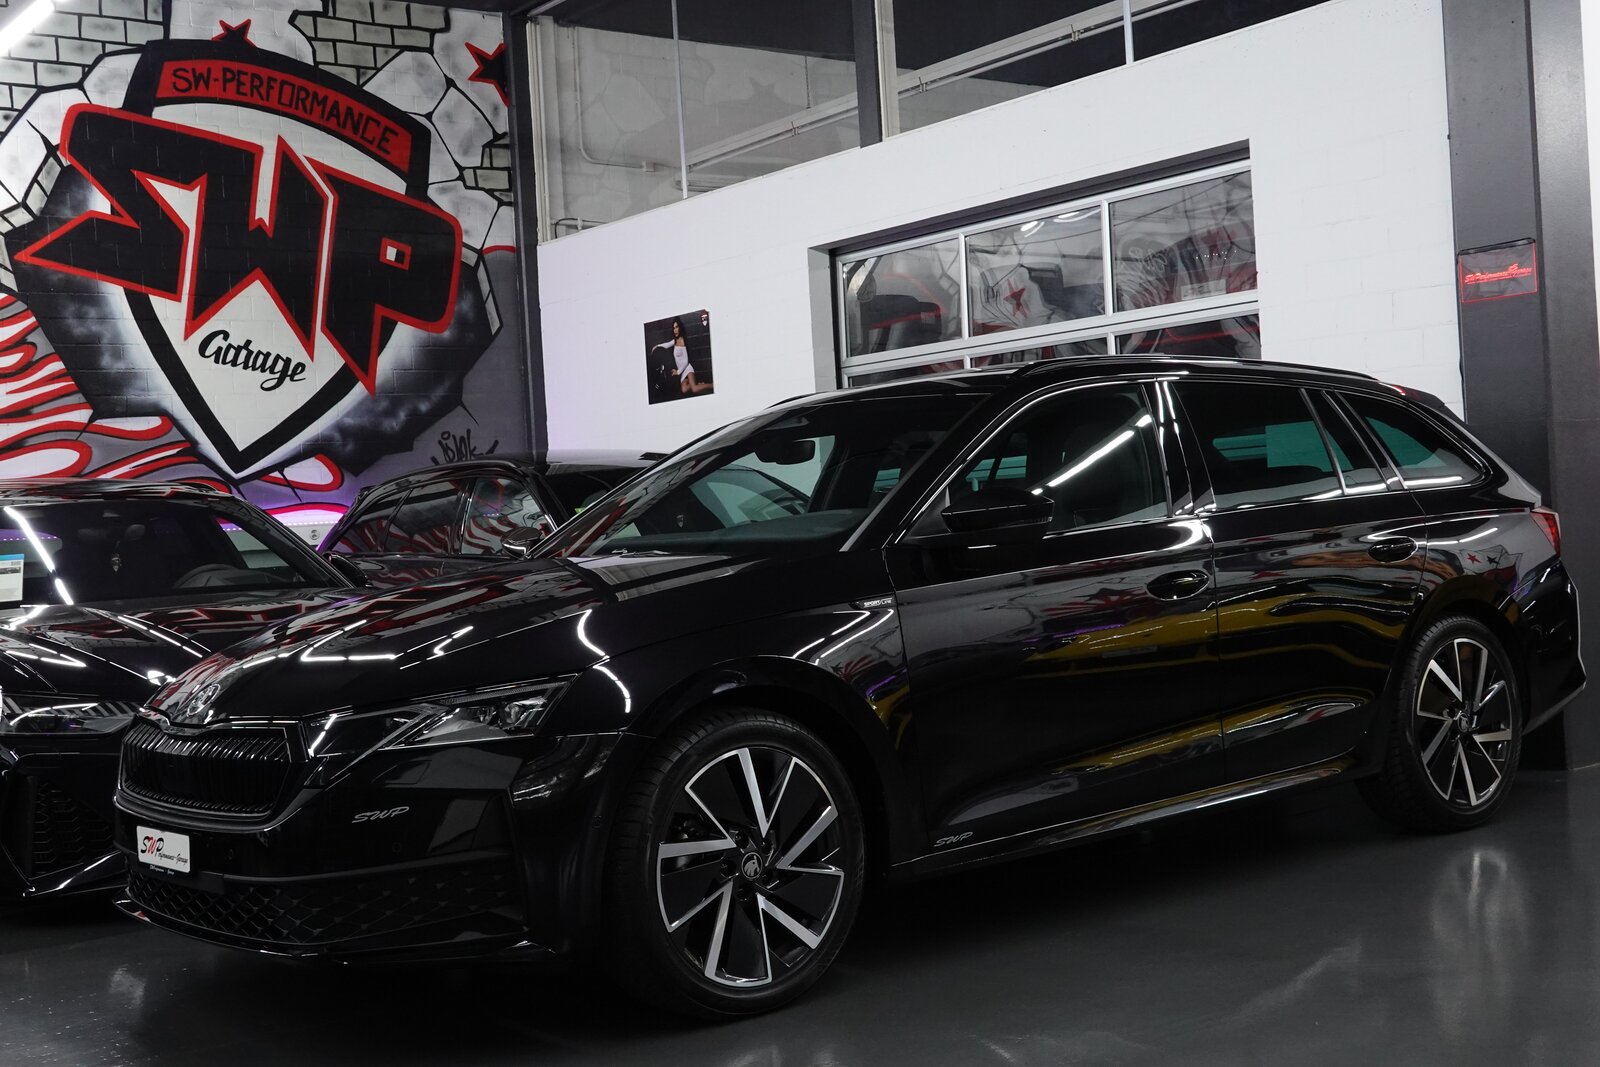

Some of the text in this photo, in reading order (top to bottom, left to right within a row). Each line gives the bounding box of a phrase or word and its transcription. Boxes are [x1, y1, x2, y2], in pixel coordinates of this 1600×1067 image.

[172, 66, 398, 155] SW-PERFORMANCE
[14, 103, 463, 397] SWP
[198, 329, 307, 391] Garage
